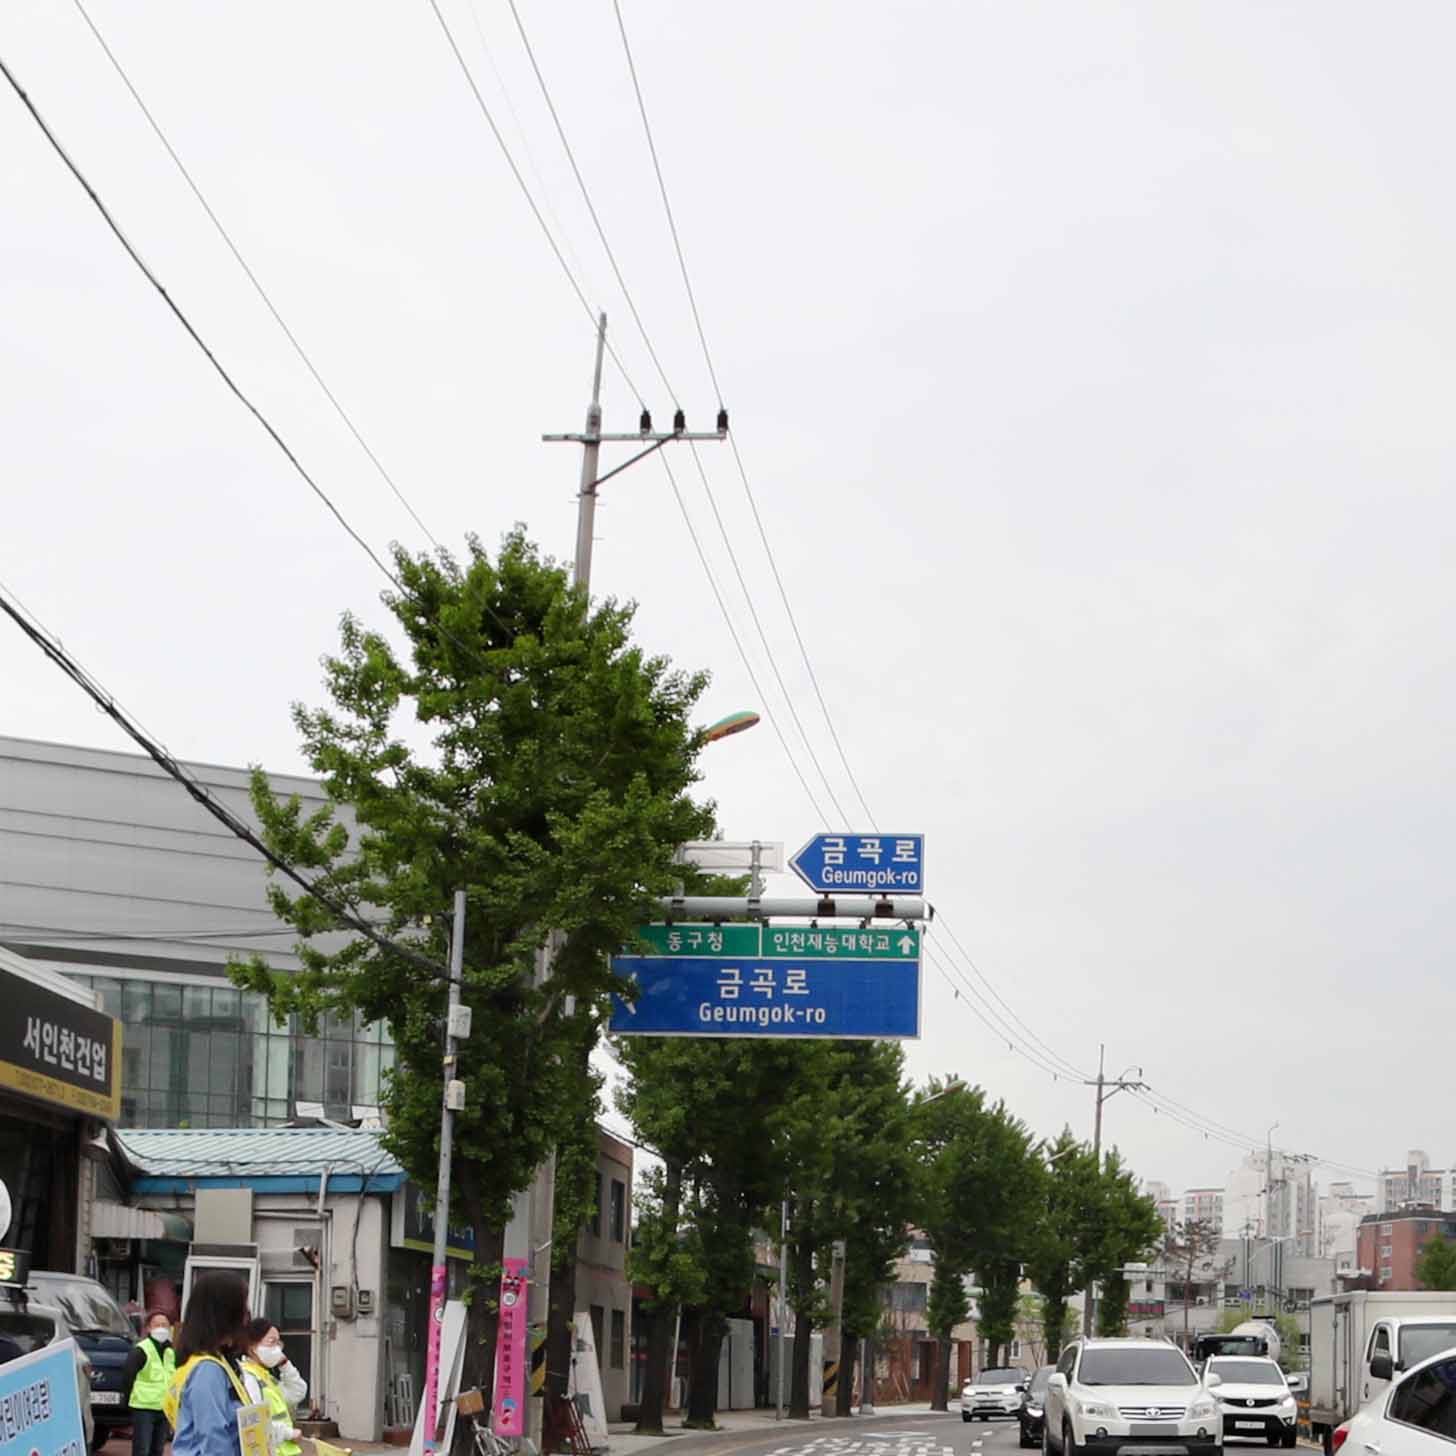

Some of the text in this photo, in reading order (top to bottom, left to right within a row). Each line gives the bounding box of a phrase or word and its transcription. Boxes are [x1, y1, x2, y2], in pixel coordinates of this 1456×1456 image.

[821, 838, 919, 865] 금곡로
[821, 866, 919, 888] Geumgok-ro
[665, 931, 725, 952] 동구청
[773, 932, 891, 954] 인천재능대학교
[716, 967, 811, 999] 금곡로
[698, 1002, 827, 1026] Geumgok-ro
[24, 1016, 107, 1082] 서인천건업
